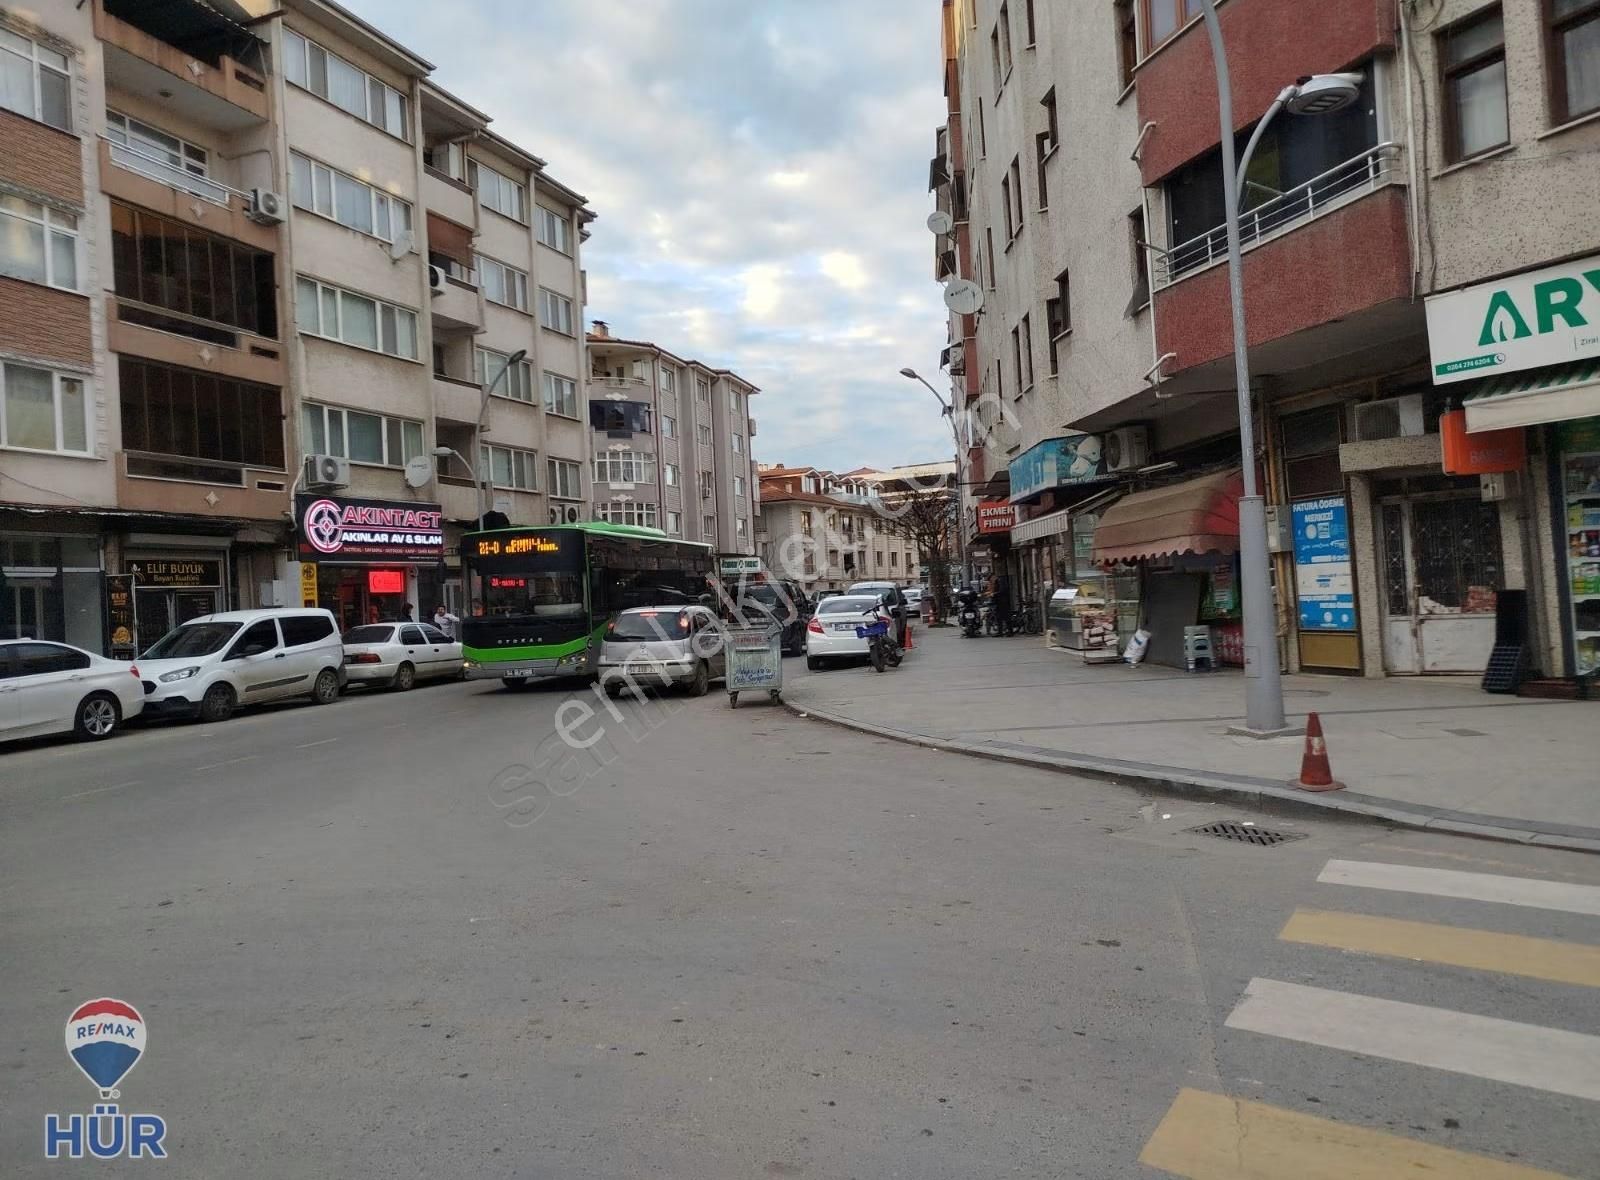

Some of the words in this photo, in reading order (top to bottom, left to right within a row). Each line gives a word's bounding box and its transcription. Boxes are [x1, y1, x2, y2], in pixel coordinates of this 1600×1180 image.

[980, 505, 1015, 517] EKMEK
[1292, 501, 1319, 513] FATURA
[1318, 497, 1345, 509] ÖDEME
[341, 505, 441, 528] AKINTACT
[984, 517, 1012, 528] FIRINI
[341, 532, 389, 543] AKINLAR
[391, 533, 405, 544] AV
[405, 534, 414, 544] &
